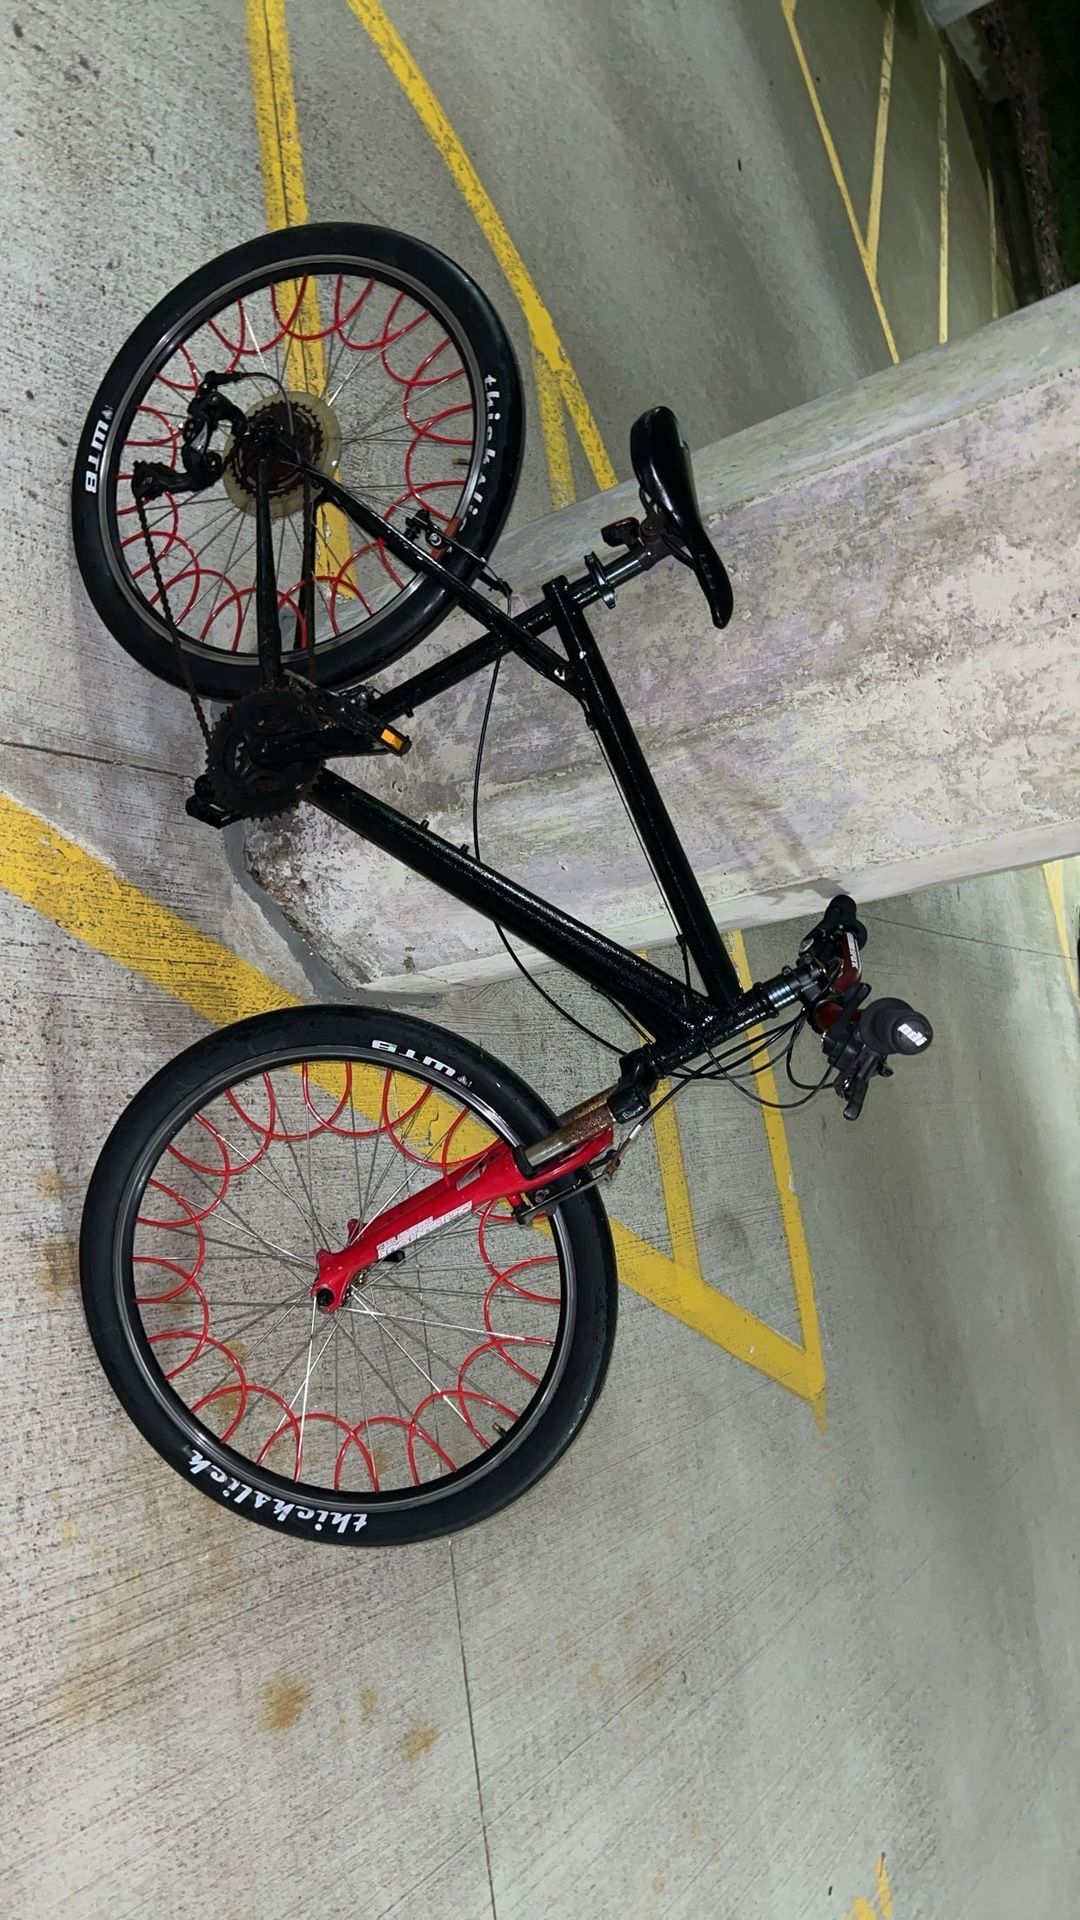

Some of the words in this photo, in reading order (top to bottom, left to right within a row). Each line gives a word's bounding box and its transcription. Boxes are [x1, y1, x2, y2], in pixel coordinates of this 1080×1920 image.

[85, 420, 109, 493] WTB
[371, 1040, 456, 1077] WTB
[190, 1450, 368, 1534] thickslick
